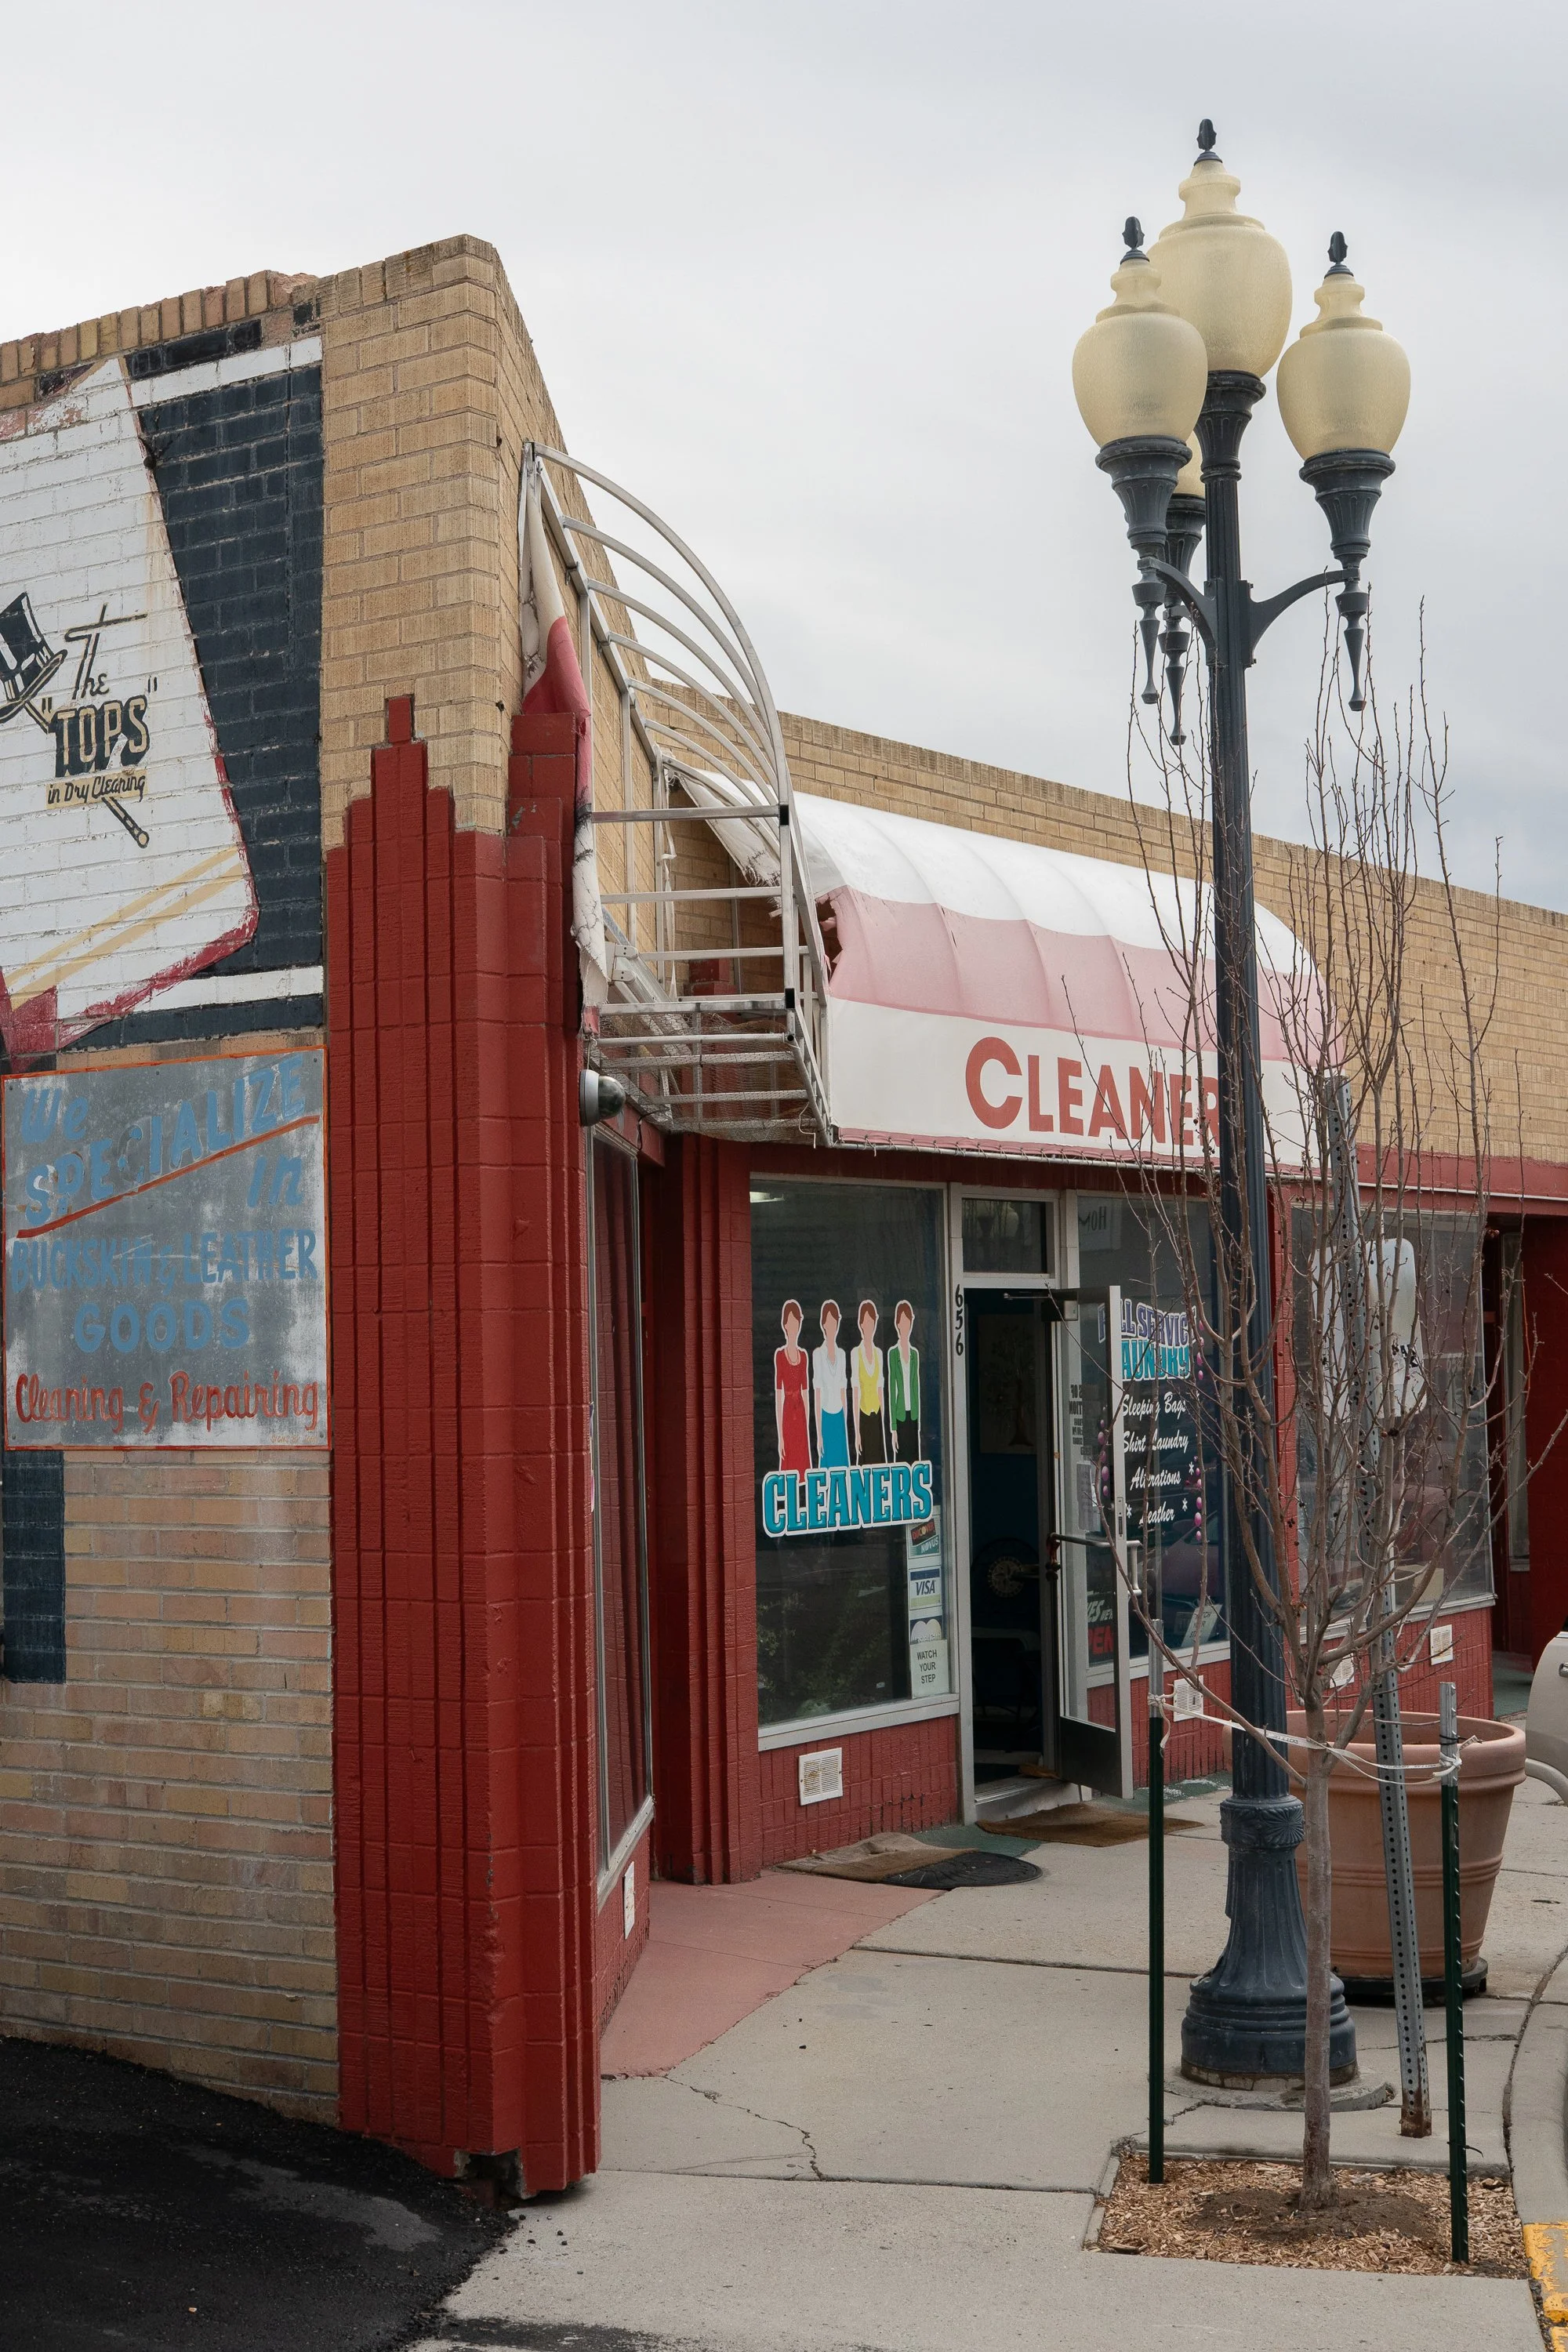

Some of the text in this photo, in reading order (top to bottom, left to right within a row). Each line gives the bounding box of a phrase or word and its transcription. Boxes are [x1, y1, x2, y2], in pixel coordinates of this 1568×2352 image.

[64, 603, 147, 699] The
[48, 775, 146, 804] in Dry Cleaning
[20, 1087, 89, 1143] We
[184, 1229, 318, 1284] LEATHER
[78, 1298, 251, 1353] GOODS
[955, 1283, 964, 1356] 656
[1136, 1302, 1196, 1349] SERVIC
[1121, 1338, 1191, 1381] AUNDRY
[16, 1370, 318, 1434] Cleaning & Repairing
[1123, 1428, 1189, 1454] Shirt Laundry
[764, 1461, 932, 1536] CLEANERS
[915, 1580, 935, 1595] VISA
[916, 1649, 938, 1660] WATCH
[920, 1661, 936, 1672] YOUR
[921, 1674, 936, 1684] STEP
